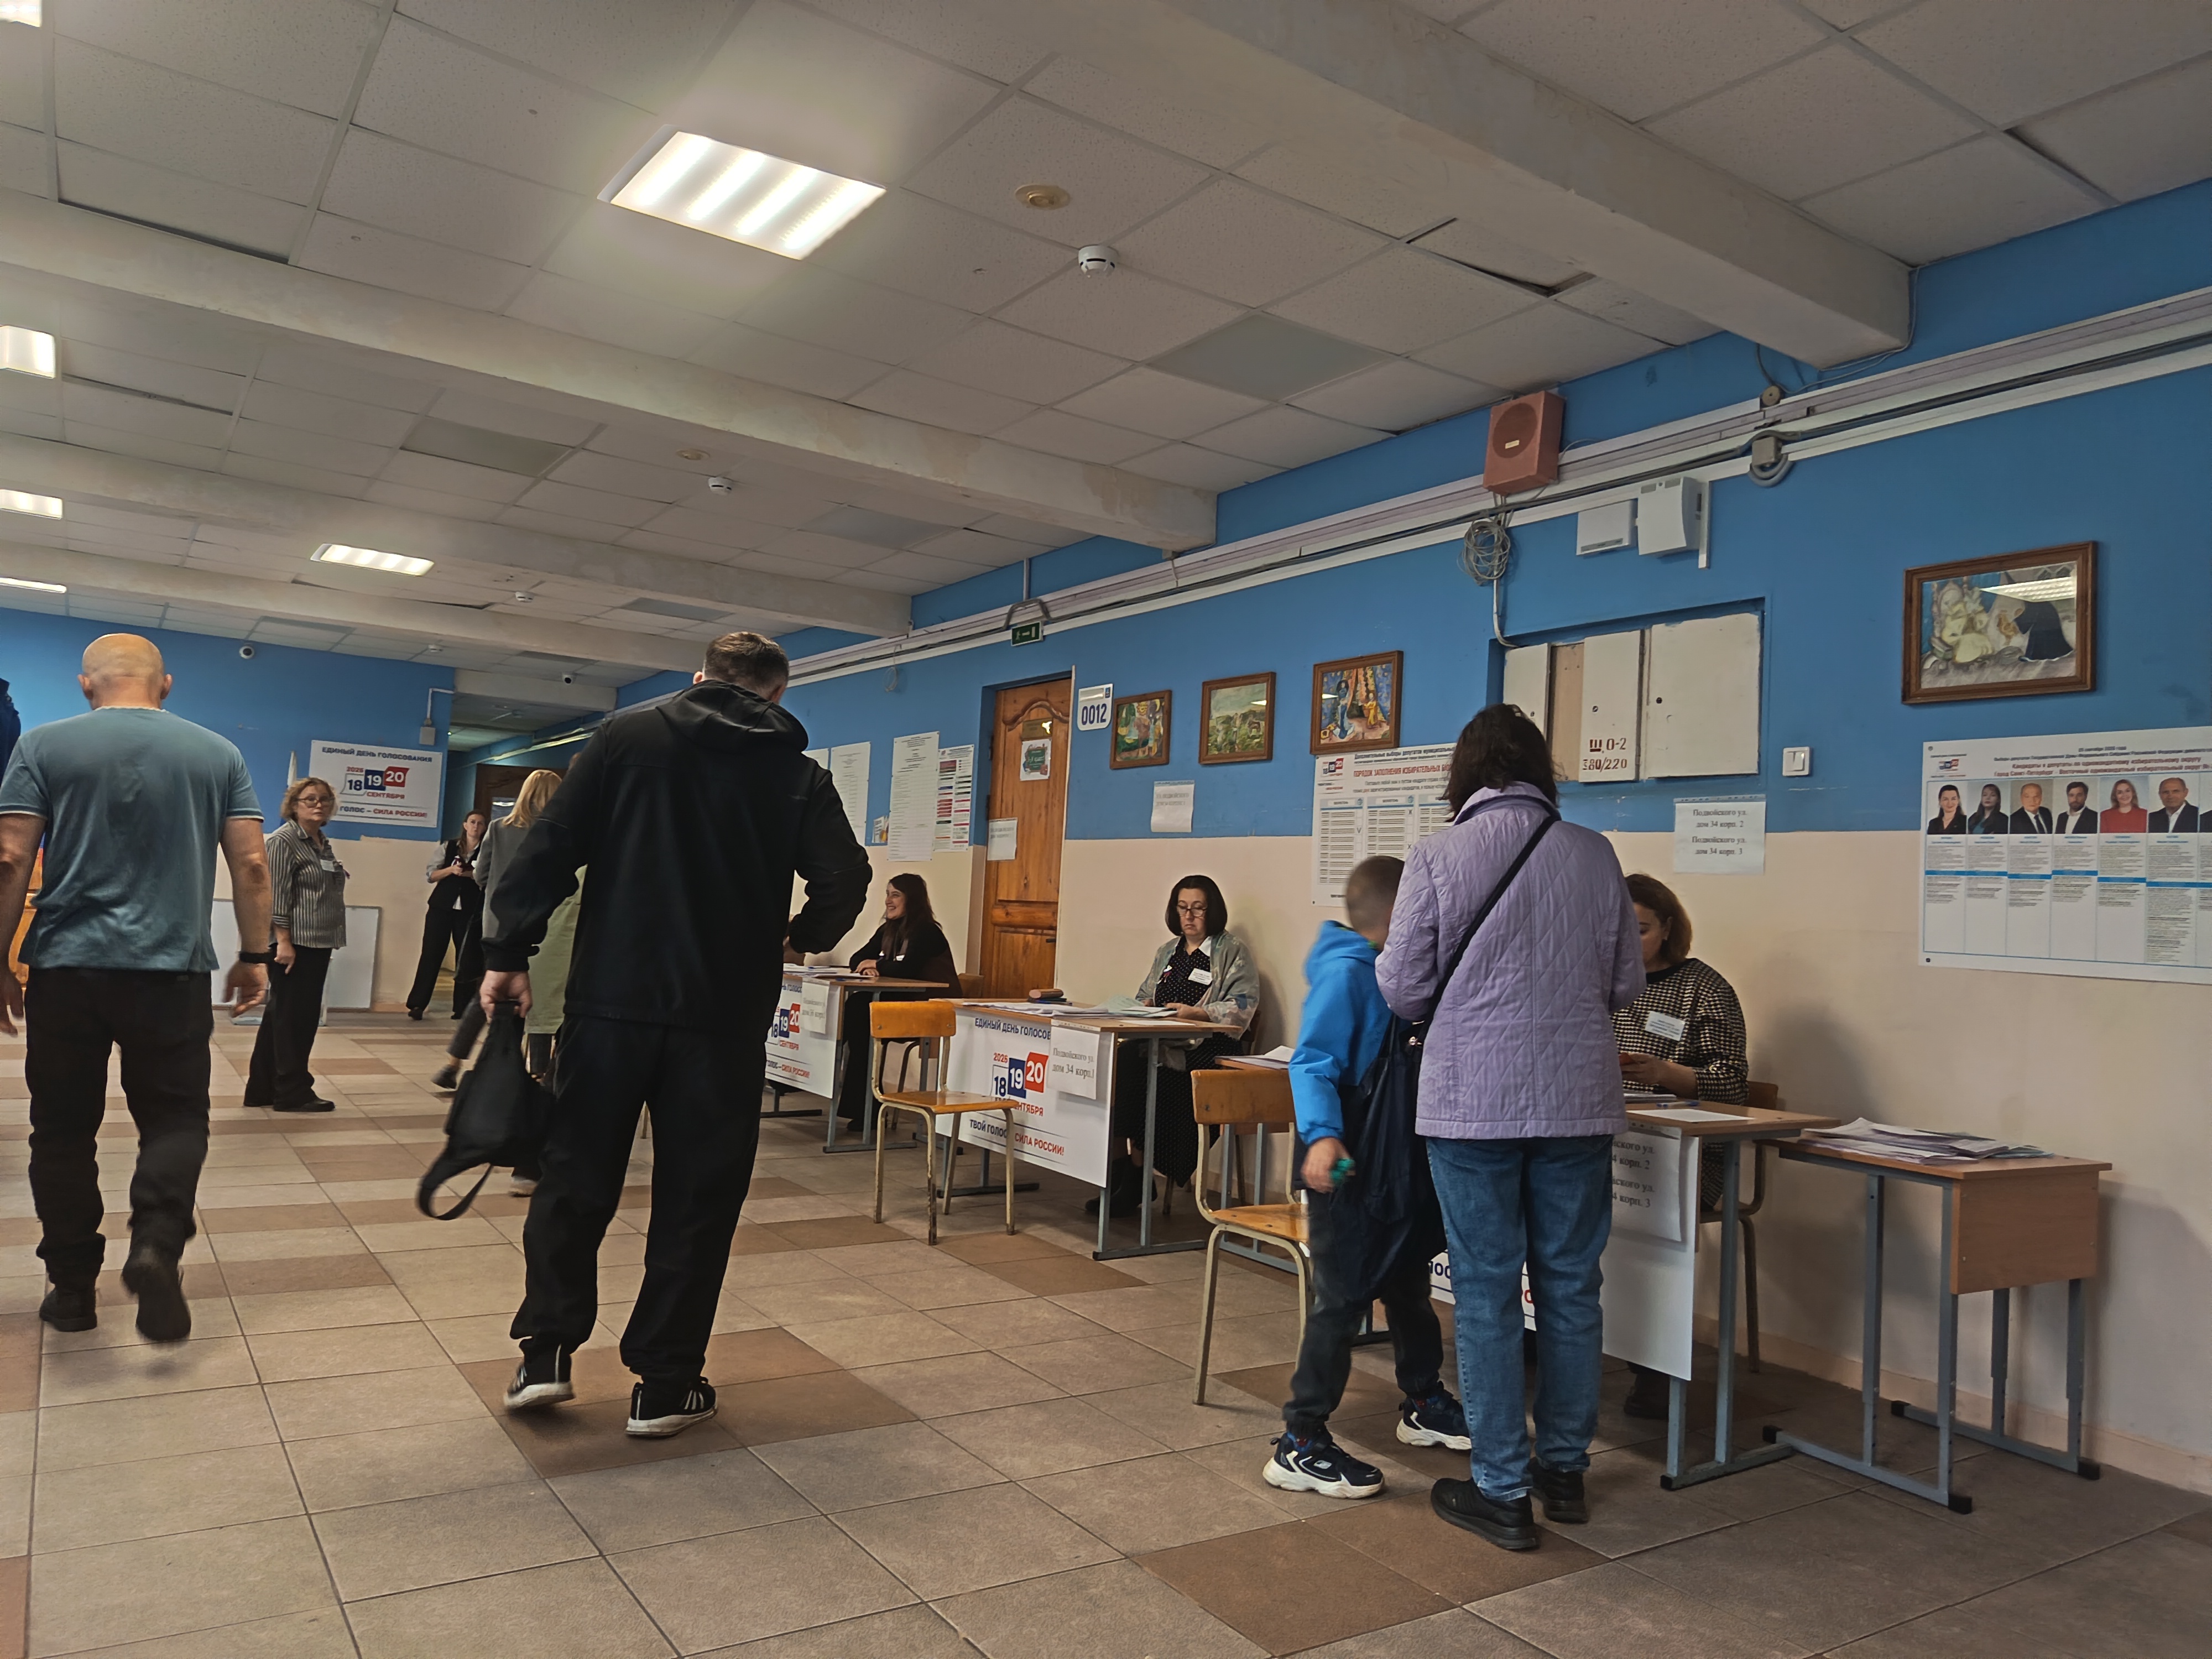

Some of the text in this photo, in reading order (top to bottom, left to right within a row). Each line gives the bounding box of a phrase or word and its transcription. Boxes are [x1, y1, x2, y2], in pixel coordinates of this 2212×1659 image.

[1082, 703, 1107, 725] 0012
[322, 747, 354, 755] ЕДИНЫЙ
[378, 752, 432, 763] ГОЛОСОВАНИЯ
[347, 771, 404, 791] 18 19 20
[780, 1016, 788, 1031] 19
[790, 1010, 800, 1026] 20
[975, 1018, 1051, 1040] ЕДИНЫЙ ДЕНЬ ГОЛОСОВ
[993, 1052, 1008, 1063] 2026
[1026, 1061, 1044, 1084] 20
[1052, 1064, 1065, 1073] дом
[1065, 1064, 1074, 1074] 34
[1010, 1067, 1024, 1089] 19
[994, 1076, 1006, 1097] 18
[1016, 1102, 1044, 1117] НТЯБРЯ
[969, 1119, 986, 1132] ТВОЙ
[1015, 1133, 1032, 1146] СИЛА
[1034, 1139, 1065, 1156] РОССИИ!
[1613, 1141, 1655, 1155] ского ул.
[1620, 1158, 1642, 1168] корп.
[1644, 1160, 1650, 1170] 2
[1642, 1184, 1655, 1193] ул.
[1620, 1196, 1642, 1206] корп.
[1646, 1198, 1650, 1208] 3
